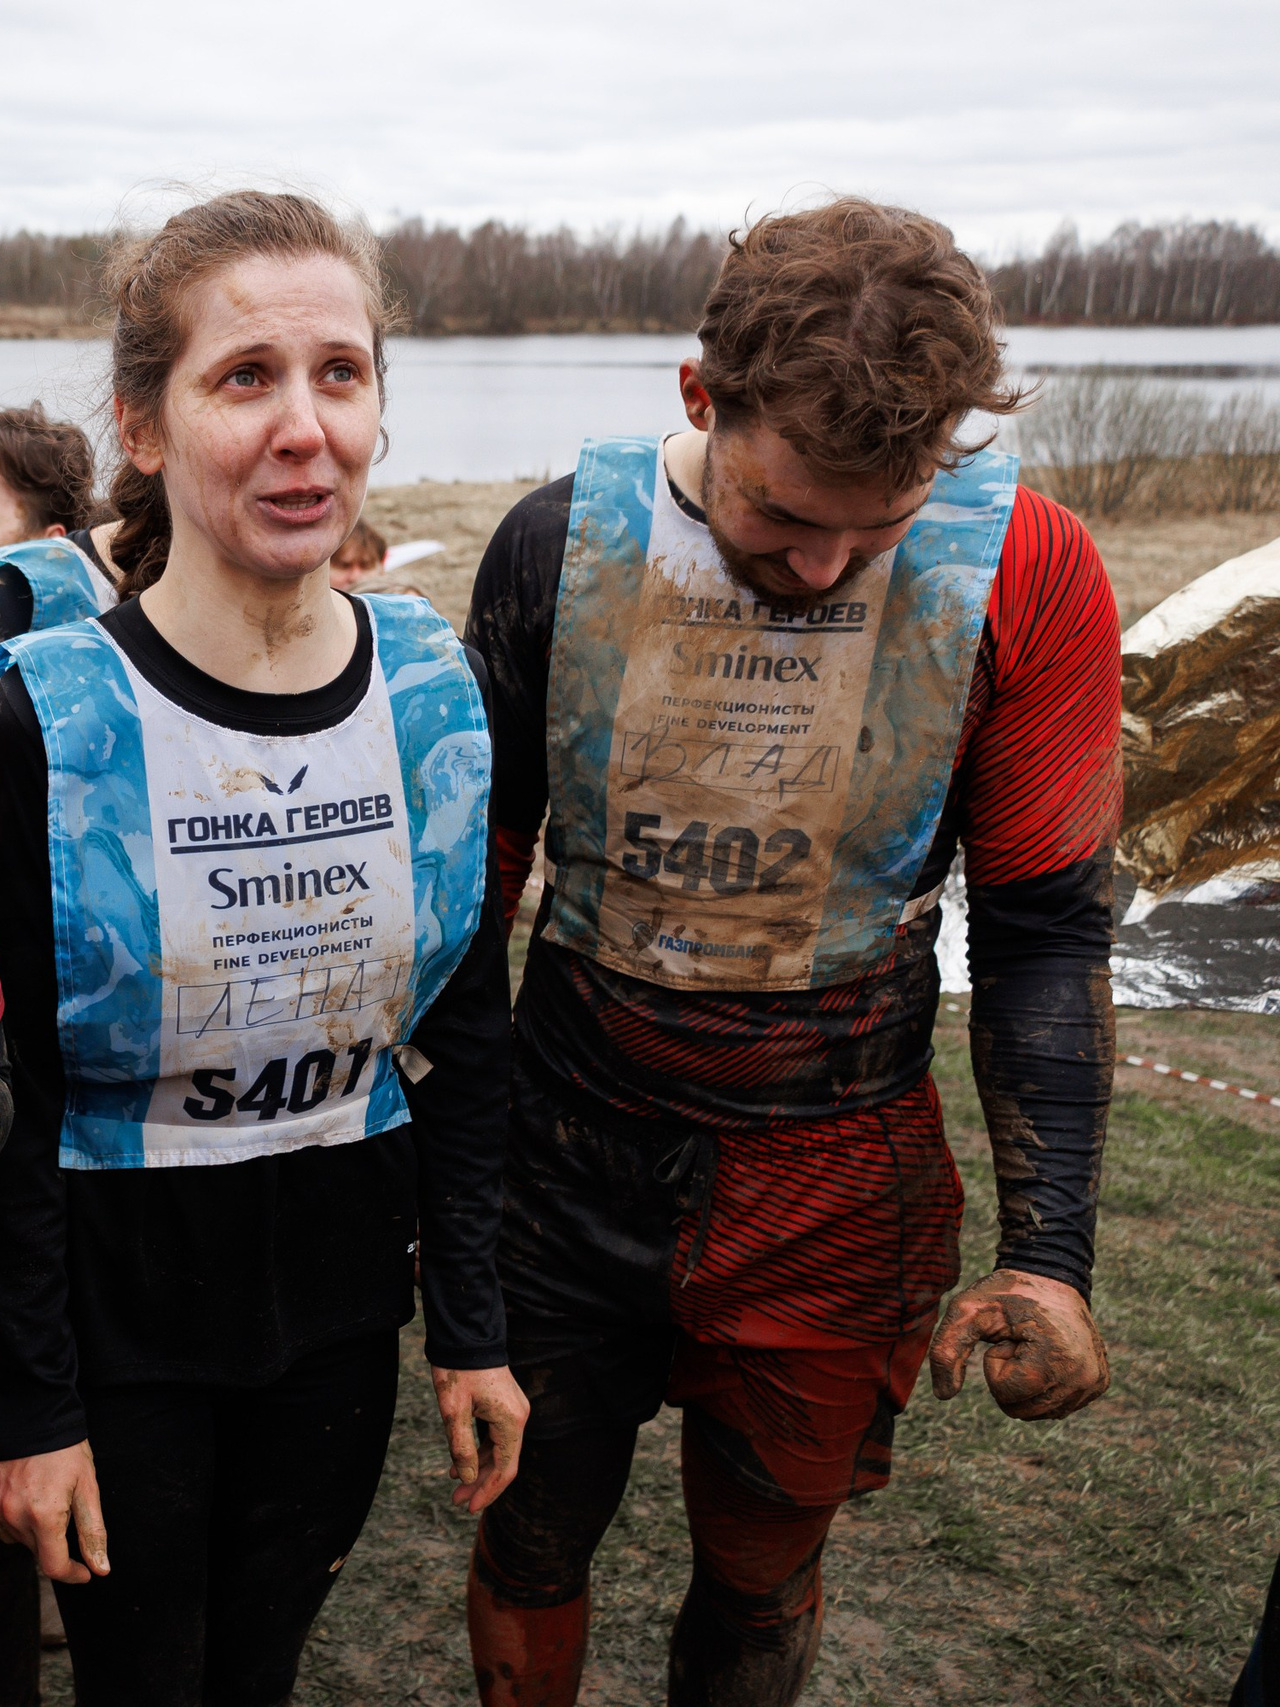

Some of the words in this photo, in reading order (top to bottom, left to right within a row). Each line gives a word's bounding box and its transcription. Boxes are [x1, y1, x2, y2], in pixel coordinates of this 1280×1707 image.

[670, 641, 822, 683] Sminex
[657, 714, 690, 728] FINE
[696, 718, 811, 735] DEVELOPMENT
[661, 695, 815, 716] ПЕРФЕКЦИОНИСТЫ
[631, 718, 832, 801] ВЛАД
[168, 811, 278, 844] ГОНКА
[285, 793, 394, 834] ГЕРОЕВ
[622, 811, 812, 896] 5402
[207, 861, 371, 910] Sminex
[212, 915, 374, 949] ПЕРФЕКЦИОНИСТЫ
[213, 954, 251, 971] FINE
[258, 937, 373, 965] DEVELOPMENT
[195, 959, 372, 1039] ЛЕНА
